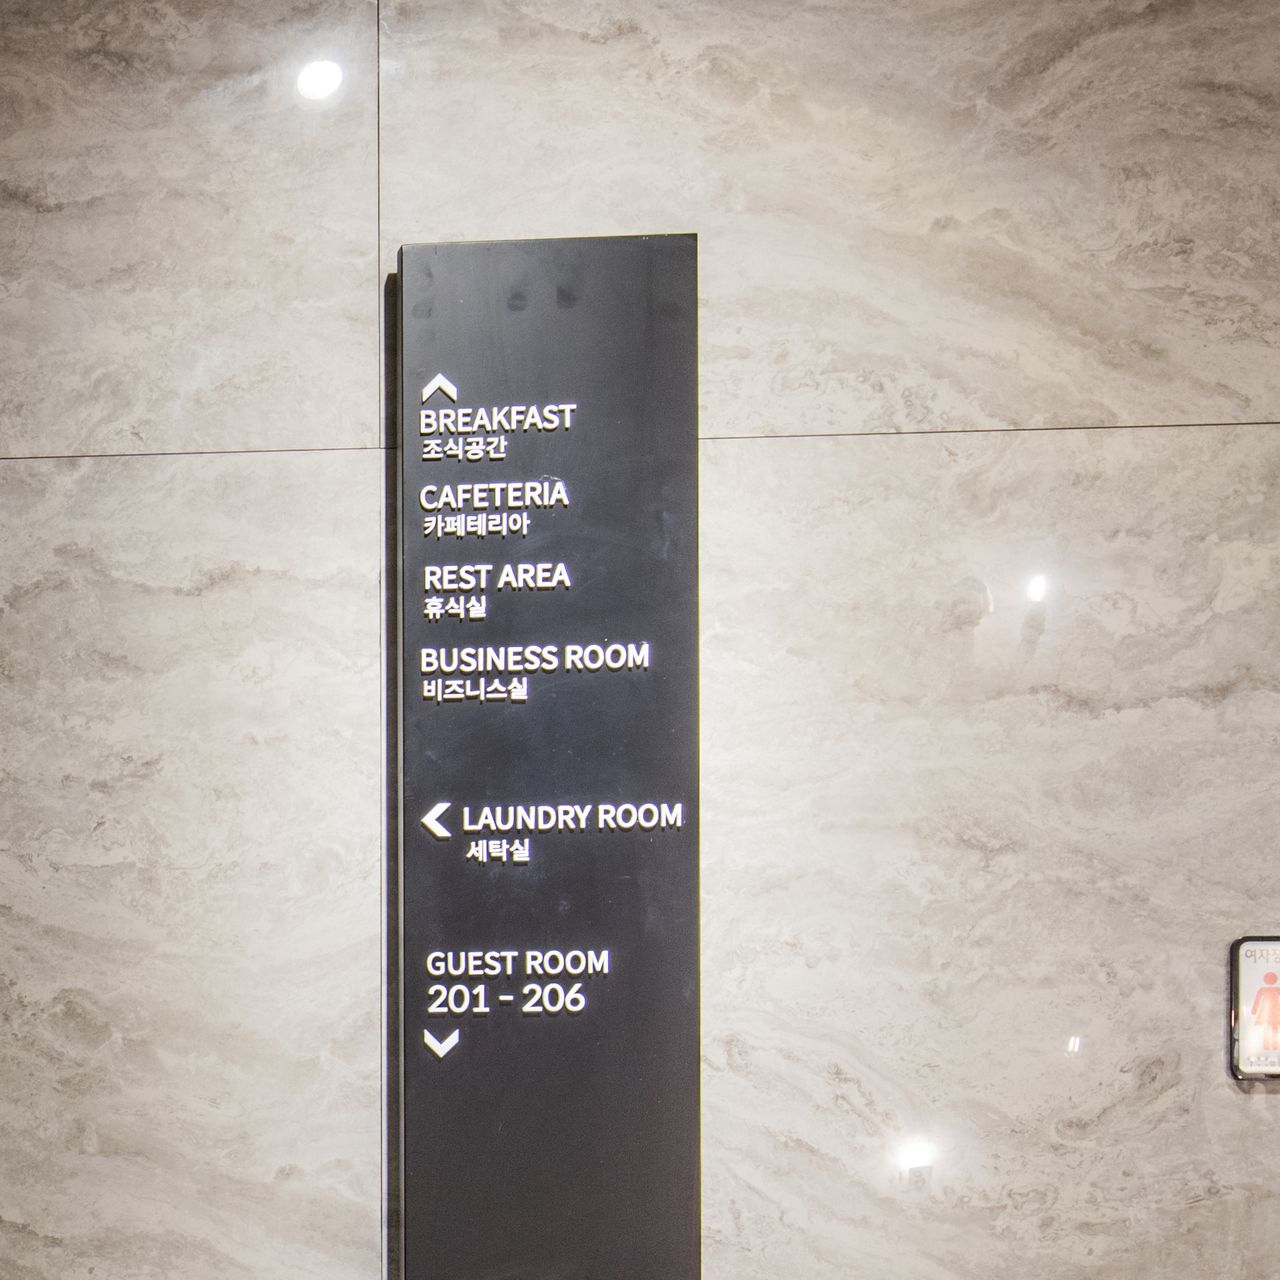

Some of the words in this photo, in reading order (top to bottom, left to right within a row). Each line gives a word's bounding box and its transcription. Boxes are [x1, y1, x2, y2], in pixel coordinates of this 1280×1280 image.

[419, 404, 577, 435] BREAKFAST
[422, 437, 508, 460] 조식공간
[420, 481, 570, 511] CAFETERIA
[424, 512, 531, 537] 카페테리아
[424, 565, 493, 591] REST
[497, 563, 571, 589] AREA
[424, 595, 487, 620] 휴식실
[420, 645, 558, 673] BUSINESS
[565, 641, 650, 669] ROOM
[423, 677, 528, 702] 비즈니스실
[463, 804, 592, 831] LAUNDRY
[598, 803, 682, 829] ROOM
[466, 838, 531, 863] 세탁실
[426, 951, 518, 976] GUEST
[526, 950, 609, 975] ROOM
[428, 984, 490, 1013] 201
[522, 983, 586, 1013] 206
